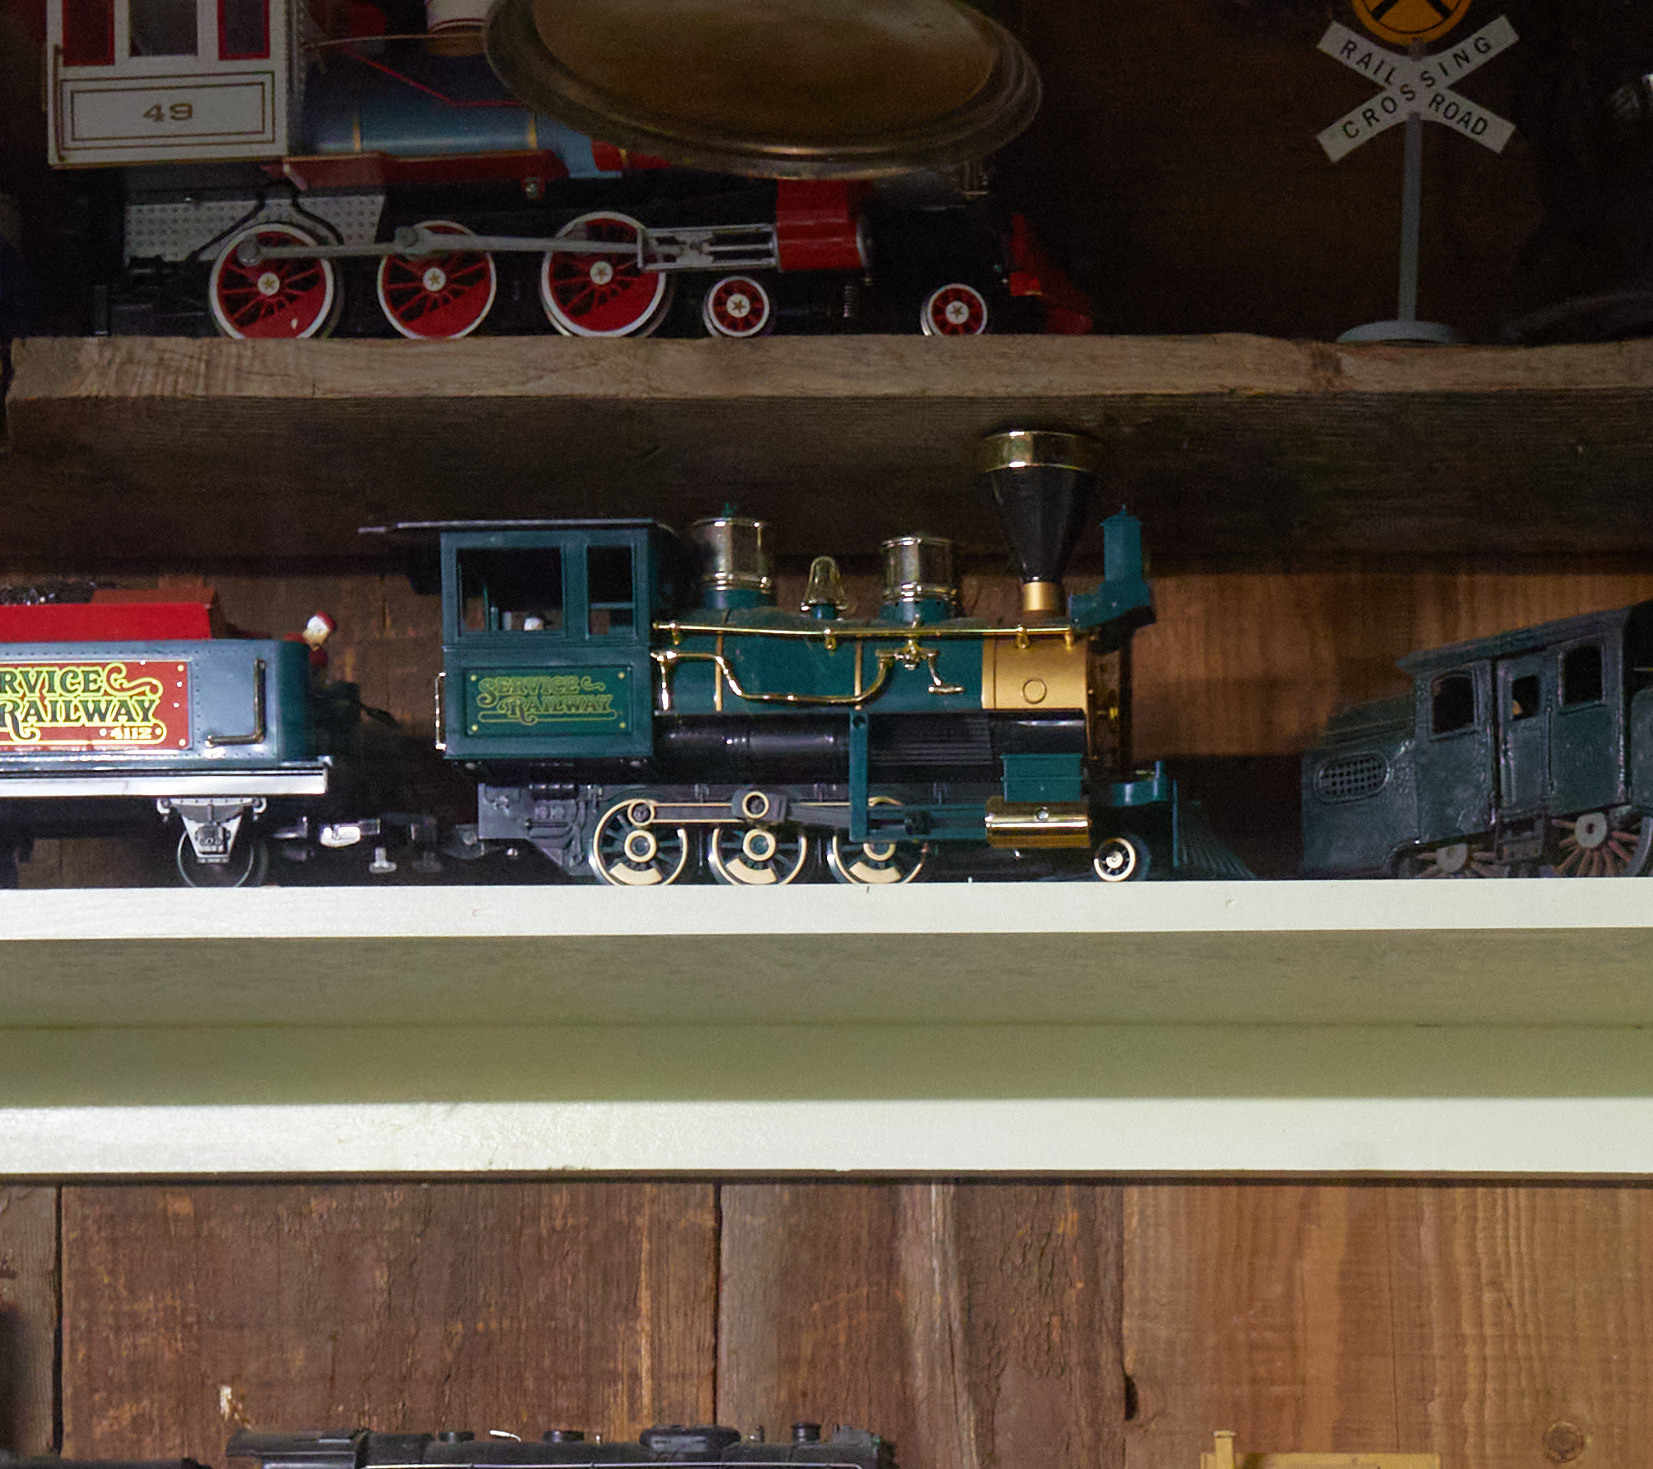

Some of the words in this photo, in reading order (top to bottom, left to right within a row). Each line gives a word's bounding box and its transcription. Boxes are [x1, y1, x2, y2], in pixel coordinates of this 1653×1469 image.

[1339, 40, 1397, 86] RAIL
[1428, 92, 1489, 136] ROAD
[1342, 36, 1492, 139] CROSSING
[142, 101, 195, 123] 49
[477, 676, 583, 708] SERVICE
[497, 694, 614, 725] RAILWAY
[110, 724, 153, 740] 4112
